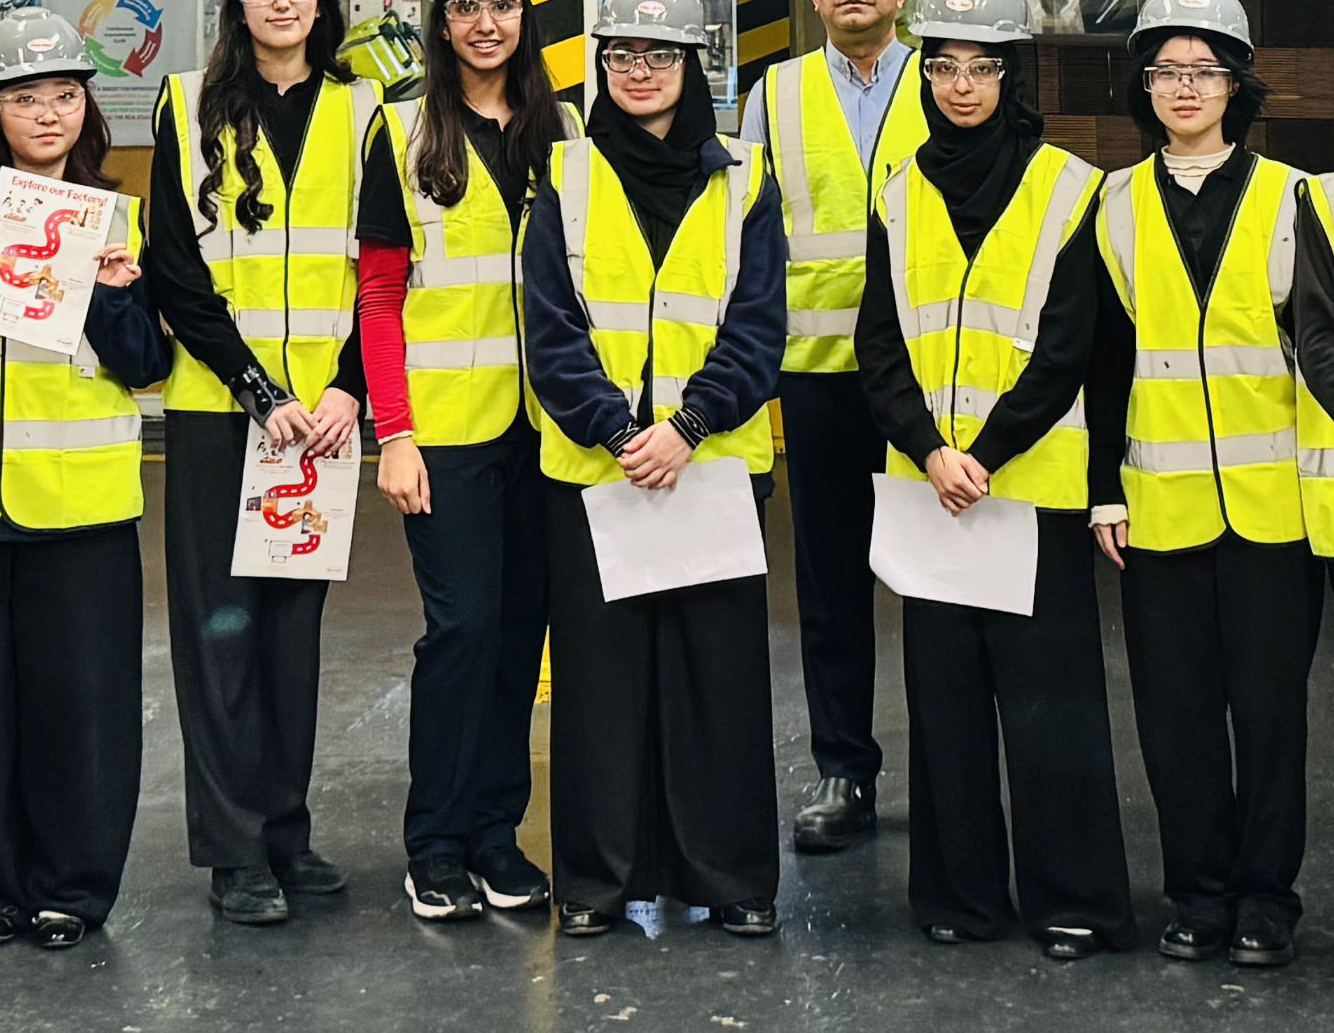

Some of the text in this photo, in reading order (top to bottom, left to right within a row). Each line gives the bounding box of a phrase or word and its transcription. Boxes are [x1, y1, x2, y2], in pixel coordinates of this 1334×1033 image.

[12, 175, 108, 208] Explore our Factory!
